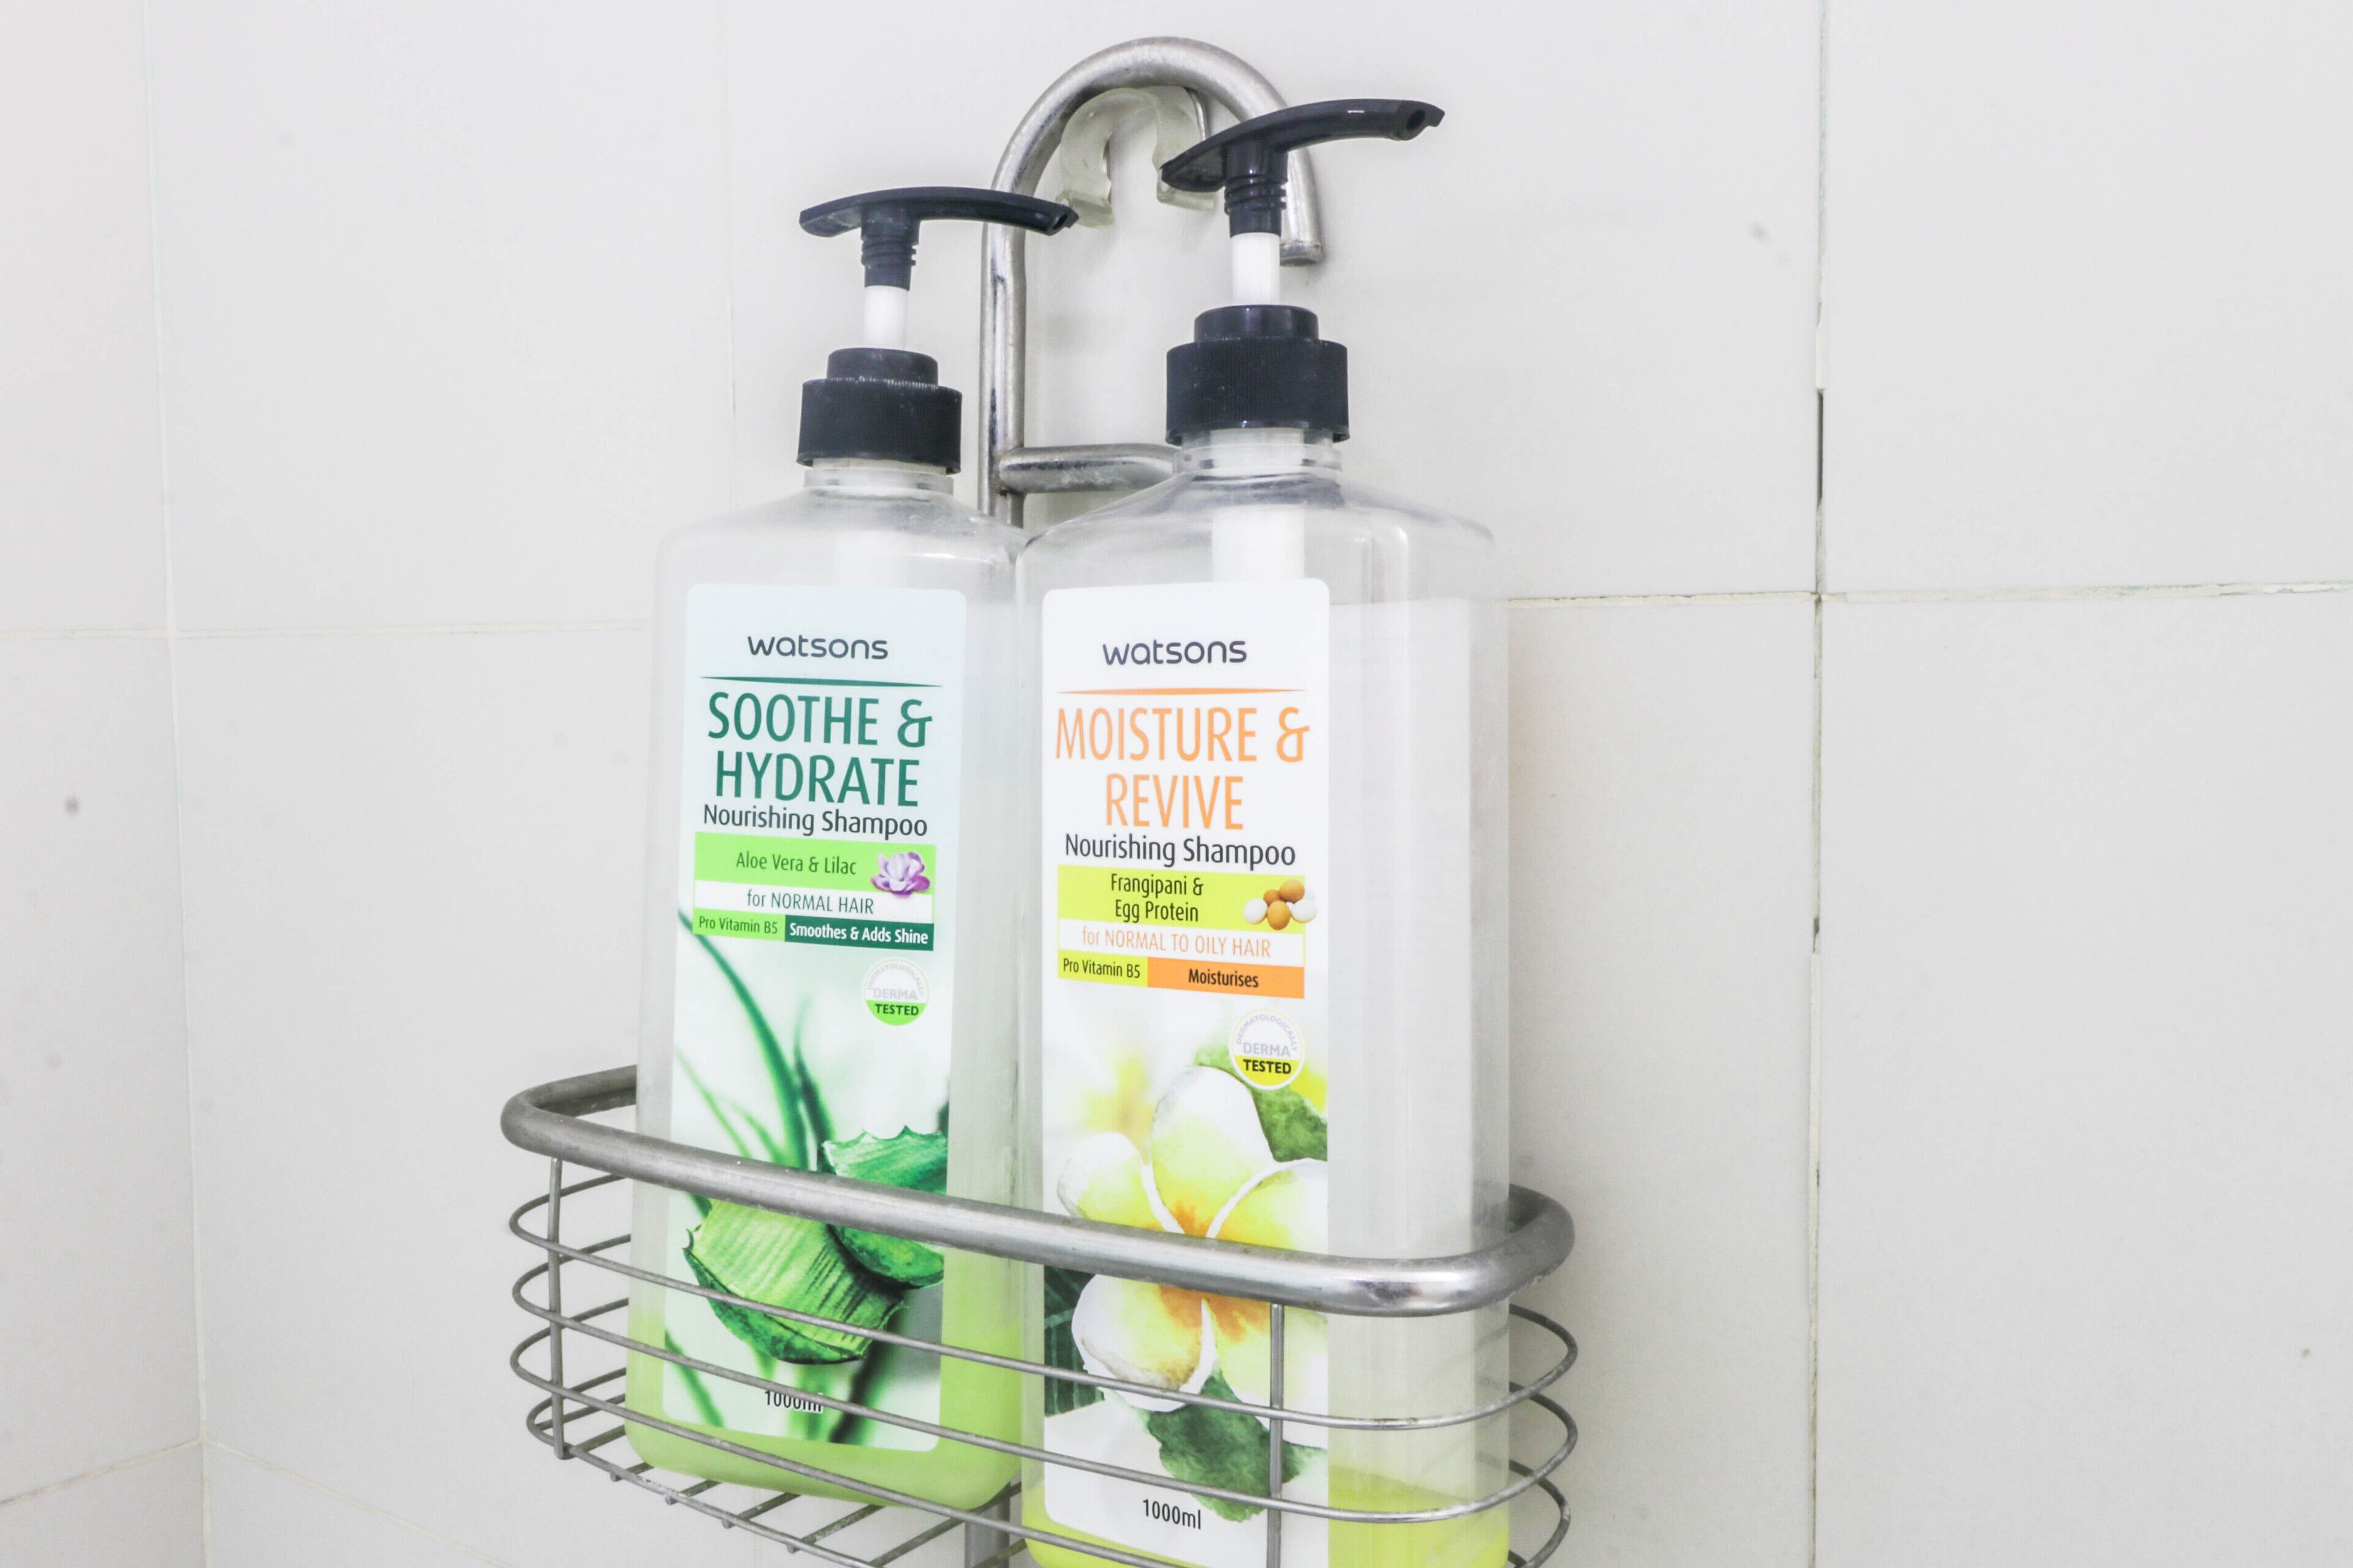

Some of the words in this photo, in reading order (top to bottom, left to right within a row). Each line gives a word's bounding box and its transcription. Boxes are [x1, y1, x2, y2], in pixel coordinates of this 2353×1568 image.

[747, 634, 889, 660] watsons
[1102, 639, 1247, 665] watsons
[708, 691, 879, 746] SOOTHE
[897, 699, 933, 748] &
[1056, 706, 1258, 762] MOISTURE
[1276, 706, 1310, 763] &
[716, 751, 920, 807] HYDRATE
[1105, 773, 1244, 830] REVIVE
[703, 804, 814, 836] Nourishing
[822, 808, 928, 841] Shampoo
[736, 851, 767, 869] Aloe
[772, 854, 803, 872] Vera
[809, 857, 819, 873] &
[825, 857, 857, 875] Lilac
[1065, 833, 1175, 868] Nourishing
[1183, 835, 1296, 871] Shampoo
[1111, 873, 1188, 899] Frangipani
[1192, 877, 1204, 896] &
[747, 889, 766, 907] for
[771, 893, 833, 912] NORMAL
[838, 896, 874, 914] HAIR
[1115, 900, 1140, 923] Egg
[1145, 901, 1199, 922] Protein
[699, 916, 716, 930] Pro
[719, 917, 760, 933] Vitamin
[764, 922, 778, 934] B5
[790, 923, 847, 941] Smoothes
[851, 926, 859, 941] &
[862, 926, 892, 942] Adds
[895, 928, 928, 944] Shine
[1082, 925, 1101, 945] for
[1105, 930, 1166, 951] NORMAL
[1171, 934, 1189, 952] TO
[1195, 935, 1227, 955] OILY
[1232, 938, 1271, 958] HAIR
[1063, 958, 1080, 973] Pro
[1082, 960, 1123, 977] Vitamin
[1127, 964, 1140, 979] B5
[1189, 968, 1259, 988] Moisturises
[873, 988, 917, 1001] DERMA
[875, 1004, 919, 1016] TESTED
[1243, 1042, 1291, 1058] DERMA
[1243, 1059, 1292, 1074] TESTED
[1142, 1499, 1201, 1529] 1000ml
